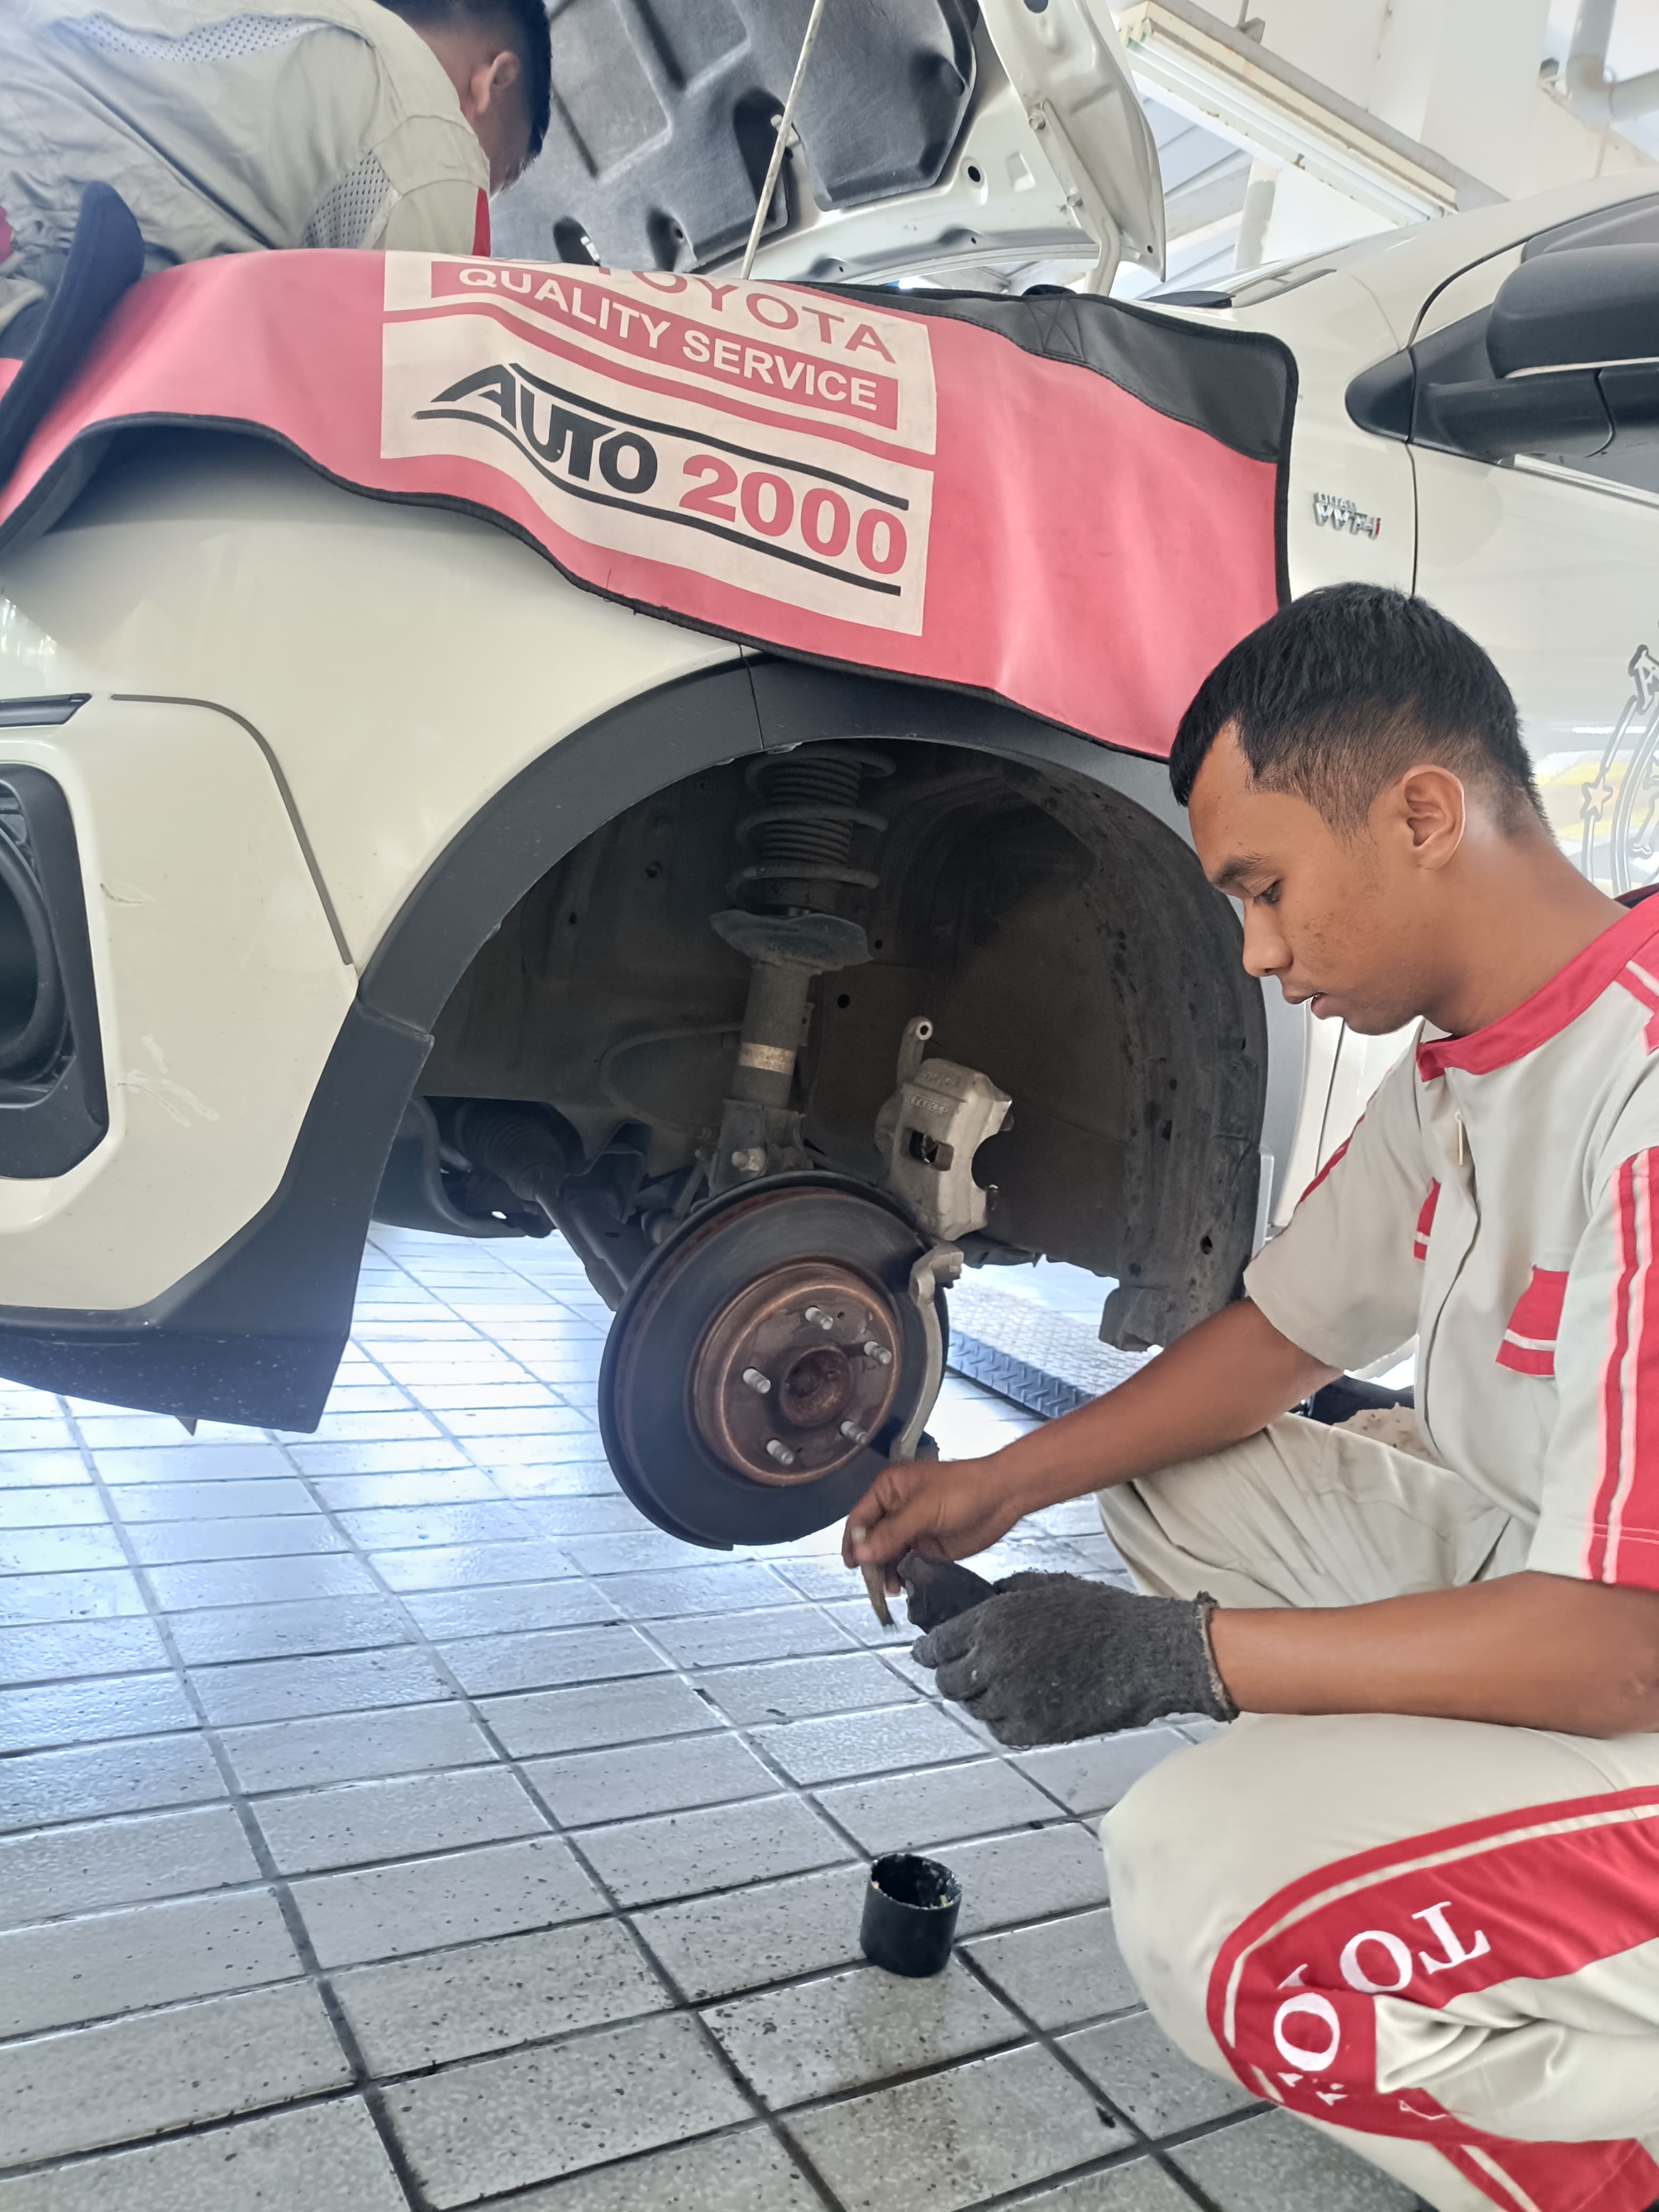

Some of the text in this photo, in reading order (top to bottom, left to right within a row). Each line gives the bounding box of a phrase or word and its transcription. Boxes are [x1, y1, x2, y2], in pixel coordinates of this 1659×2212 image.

[459, 268, 877, 411] QUALITY SERVICE
[598, 267, 897, 364] OYOTA
[430, 364, 907, 574] AUTO 2000
